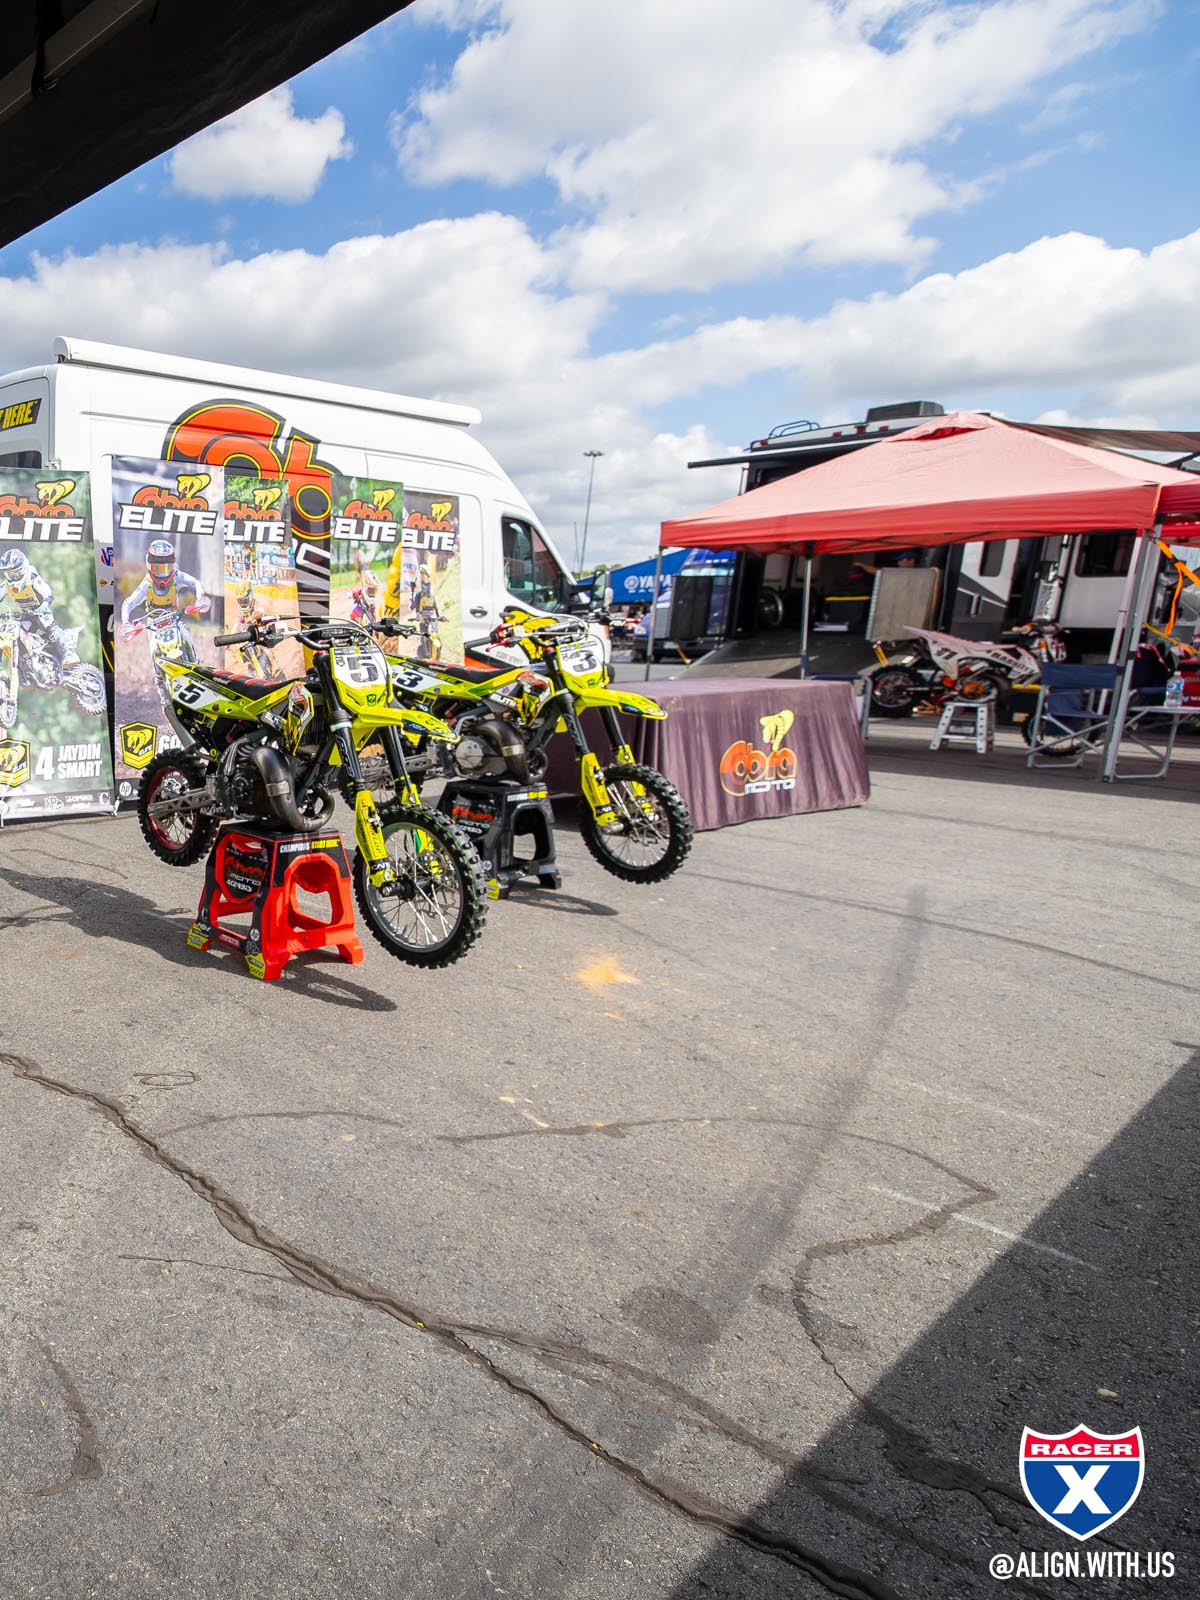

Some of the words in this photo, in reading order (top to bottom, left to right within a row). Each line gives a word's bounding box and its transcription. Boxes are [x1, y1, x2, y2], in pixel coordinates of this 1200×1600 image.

[119, 504, 218, 534] ELITE
[334, 518, 397, 542] ELITE
[402, 529, 455, 551] ELITE
[347, 656, 378, 683] 5
[571, 650, 597, 672] 3
[178, 683, 205, 704] 5
[35, 746, 55, 780] 4
[58, 743, 101, 761] JAYDIN
[57, 760, 102, 779] SMART
[720, 740, 797, 796] Cobra
